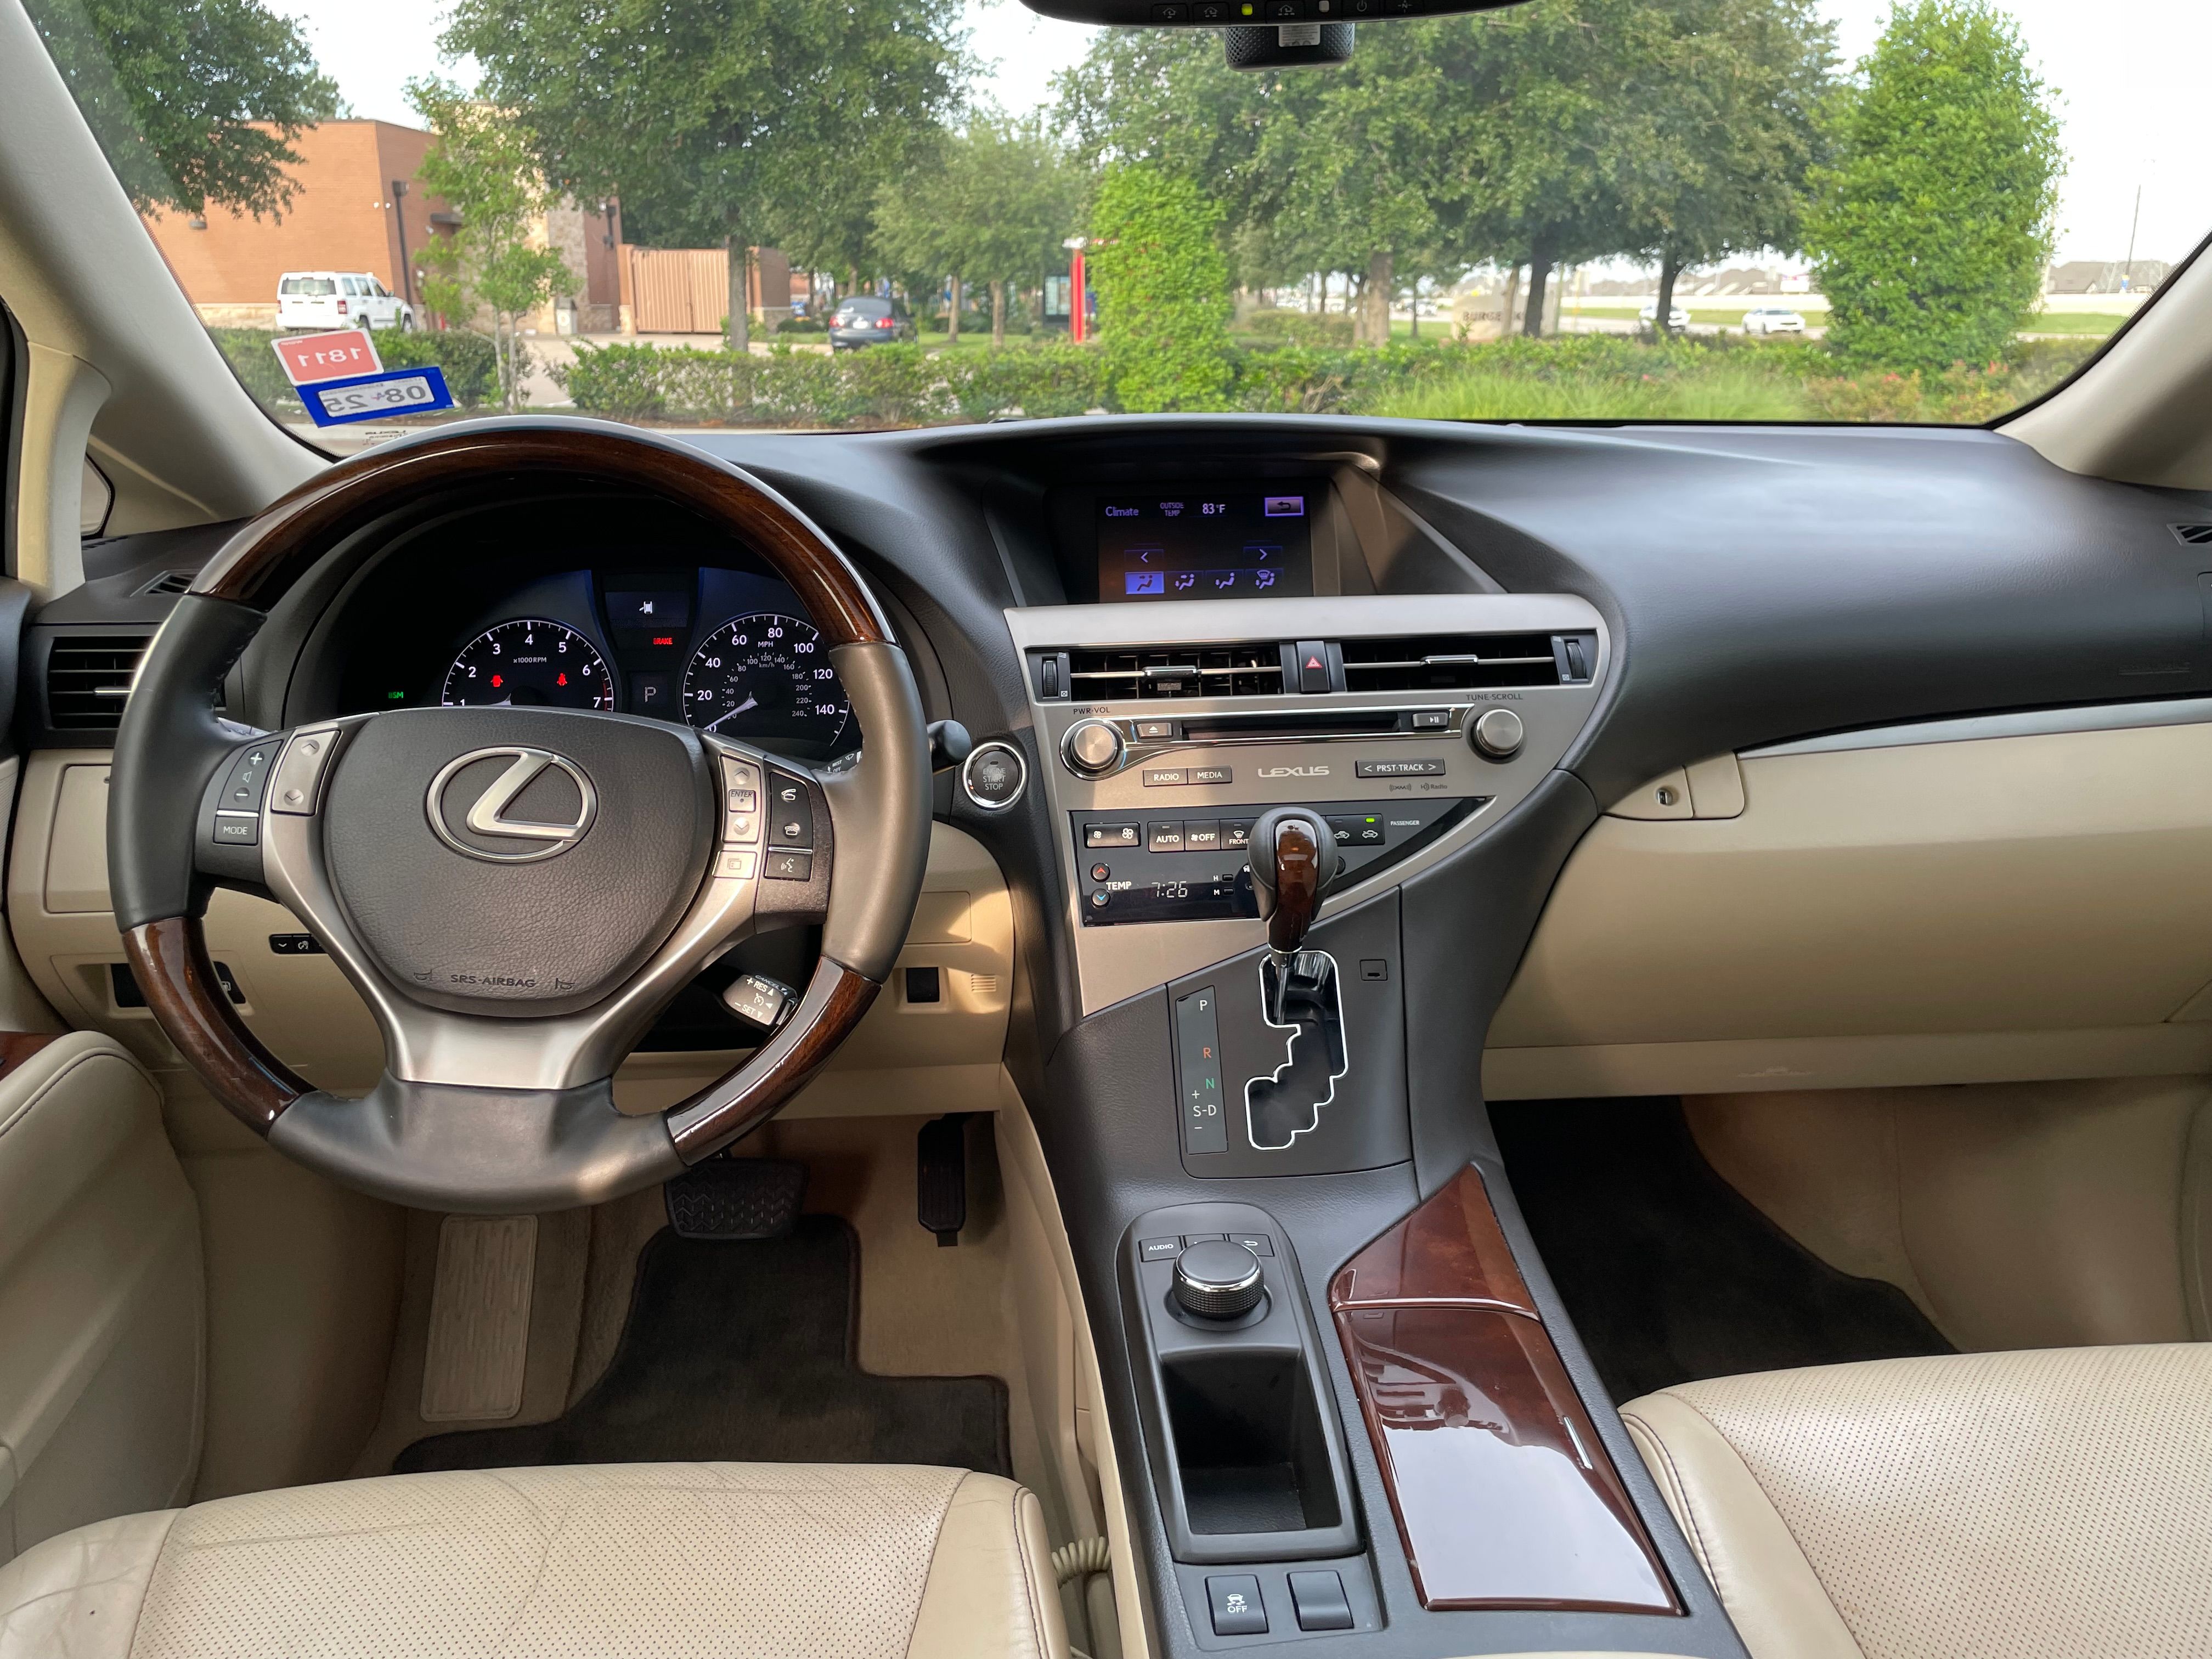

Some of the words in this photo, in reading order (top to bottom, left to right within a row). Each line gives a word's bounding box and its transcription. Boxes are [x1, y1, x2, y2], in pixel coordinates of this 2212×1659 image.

[1105, 506, 1139, 516] Climate
[768, 627, 783, 638] 80
[524, 634, 534, 645] 4
[732, 635, 747, 645] 60
[493, 644, 501, 654] 3
[558, 642, 567, 653] 5
[793, 642, 814, 653] 100
[705, 657, 721, 668] 40
[468, 667, 477, 678] 2
[582, 664, 591, 676] 6
[813, 668, 833, 680] 120
[644, 686, 657, 702] P
[697, 690, 712, 701] 20
[593, 697, 601, 708] 7
[815, 704, 835, 715] 140
[1154, 772, 1179, 782] RADIO
[1197, 771, 1223, 780] MEDIA
[1257, 766, 1330, 778] LEXUS
[223, 826, 248, 835] MODE
[1156, 834, 1180, 844] AUTO
[1198, 833, 1216, 842] OFF
[1106, 881, 1132, 890] TEMP
[1152, 881, 1188, 898] 7:26
[753, 980, 769, 992] RES
[755, 975, 780, 989] CANCEL
[742, 1004, 757, 1015] SET
[1199, 1000, 1207, 1011] P
[1203, 1047, 1212, 1059] R
[1205, 1077, 1215, 1089] N
[1148, 1243, 1174, 1251] AUDIO
[1227, 1605, 1248, 1613] OFF
